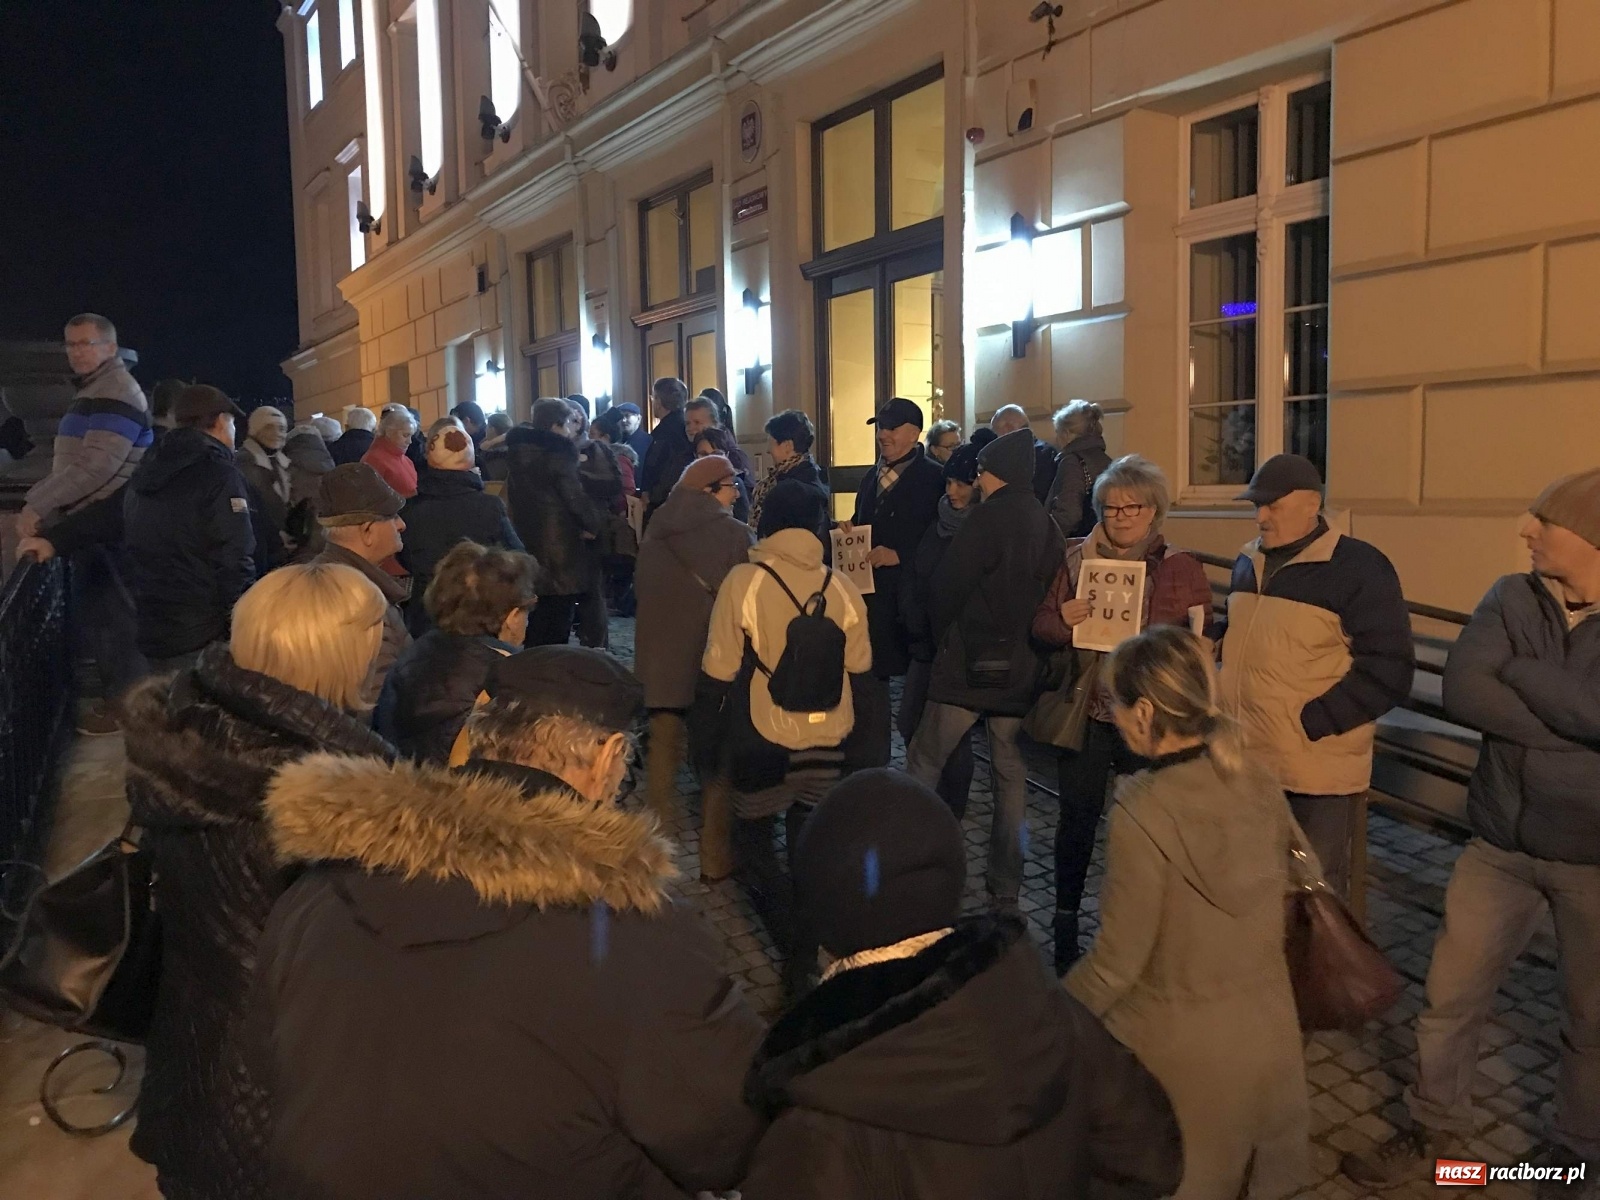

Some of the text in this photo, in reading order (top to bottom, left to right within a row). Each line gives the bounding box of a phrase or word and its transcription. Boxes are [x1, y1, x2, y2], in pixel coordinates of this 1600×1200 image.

[836, 535, 865, 547] KON
[838, 548, 864, 560] STY
[839, 561, 865, 572] TUC
[1089, 571, 1135, 586] KON
[1088, 589, 1133, 604] STY
[1087, 605, 1131, 621] TUC
